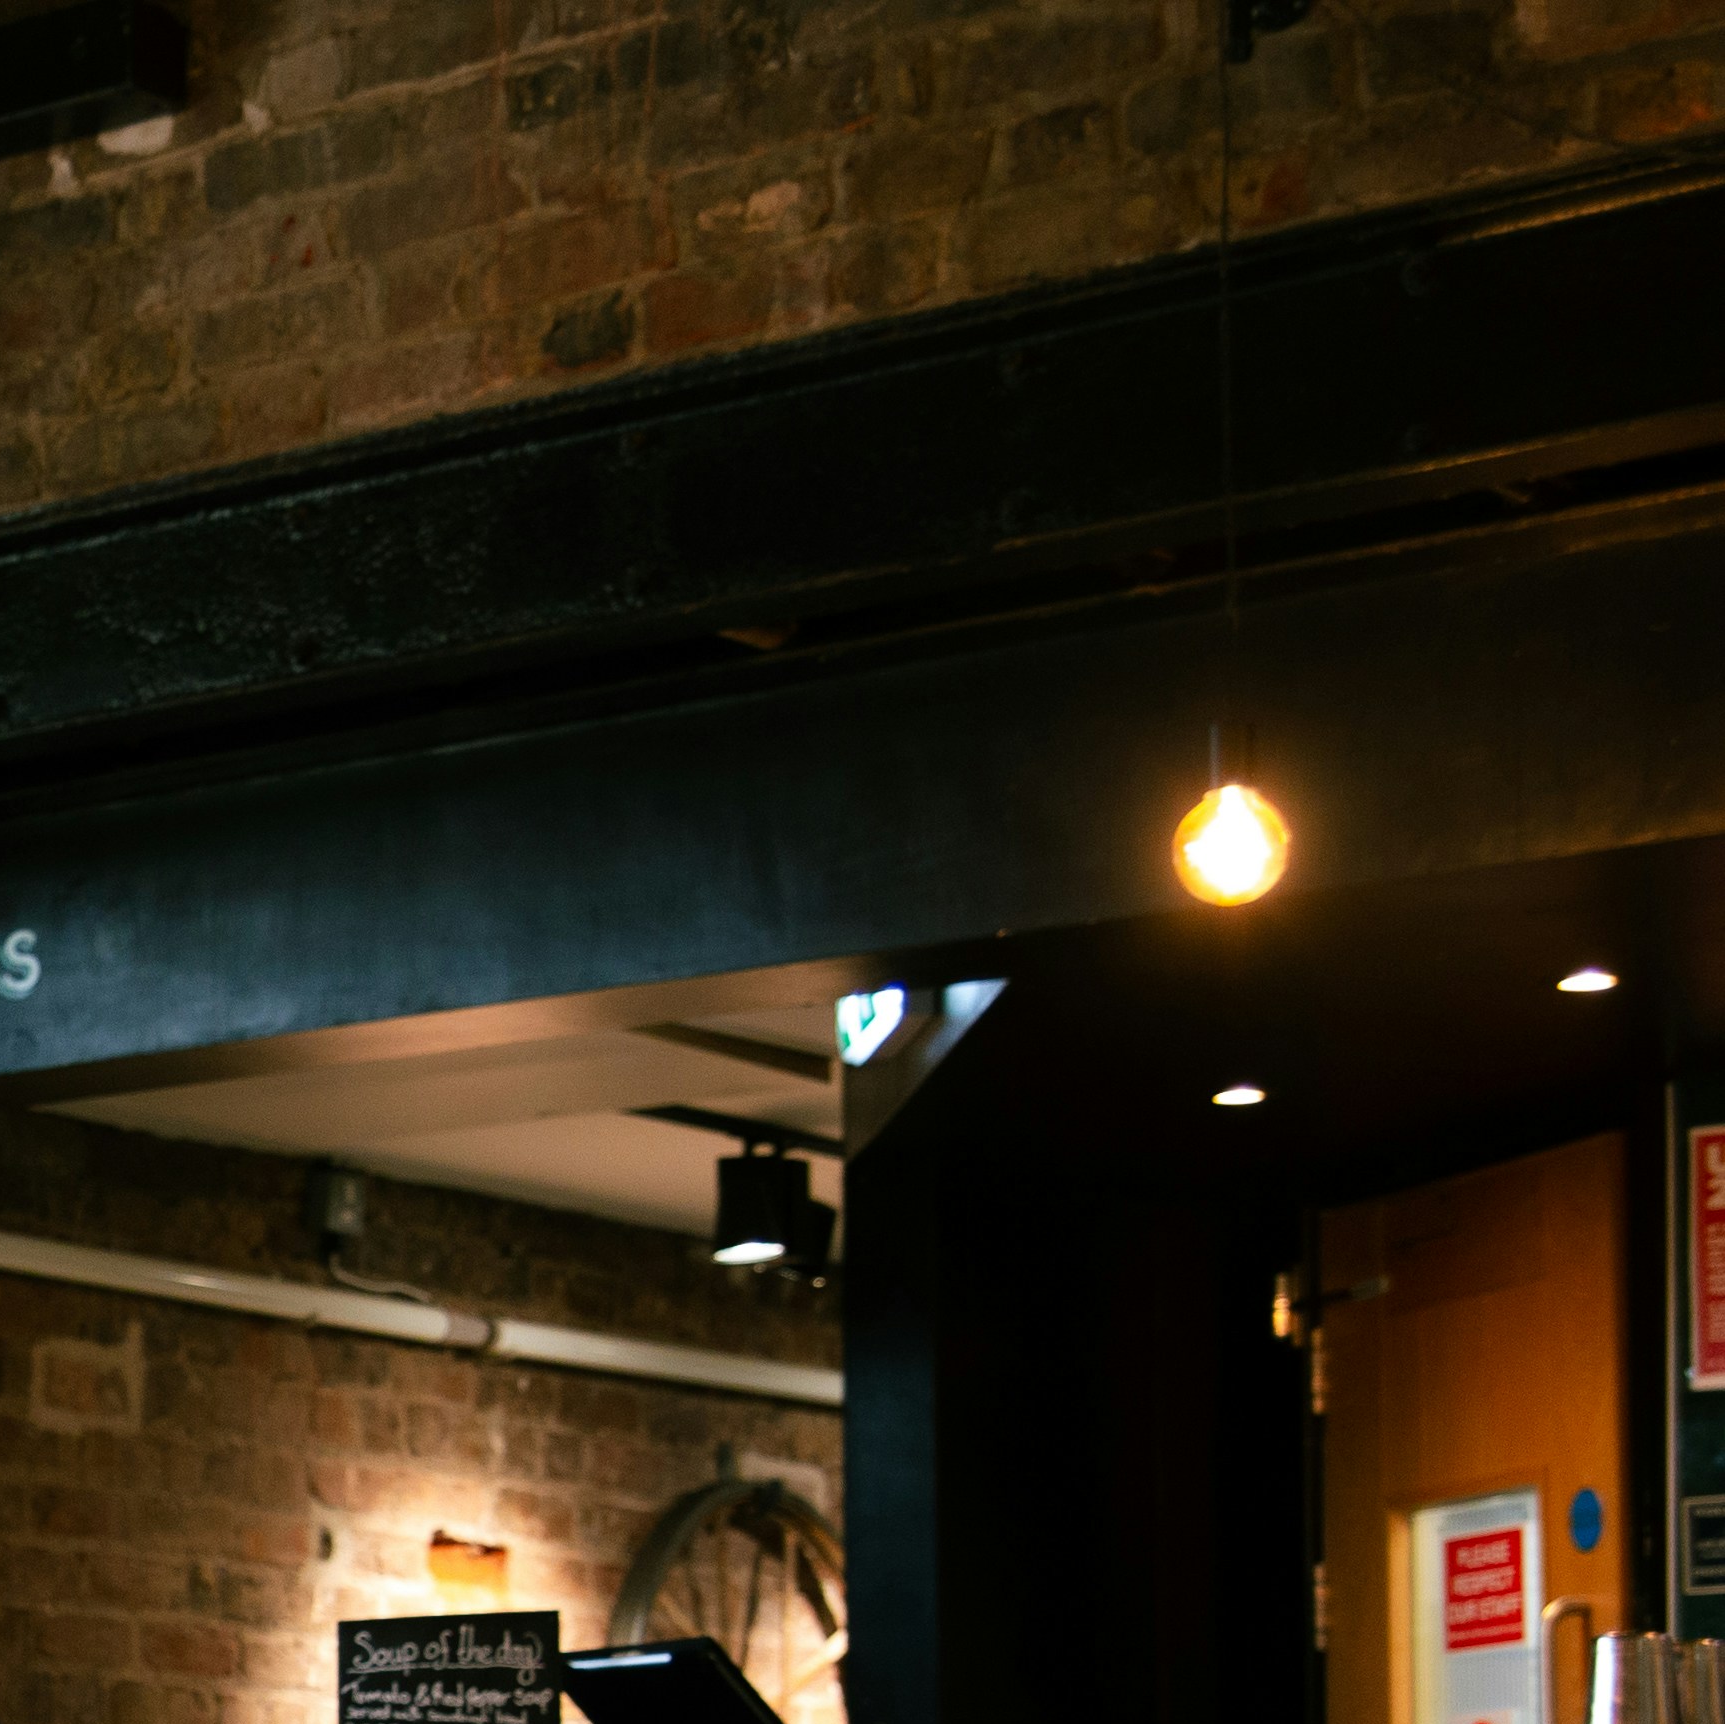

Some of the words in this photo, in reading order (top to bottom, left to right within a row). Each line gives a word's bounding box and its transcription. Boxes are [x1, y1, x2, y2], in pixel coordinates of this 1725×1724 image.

[352, 1630, 419, 1677] Soup
[423, 1628, 453, 1671] of
[456, 1623, 493, 1666] the
[493, 1629, 544, 1687] day
